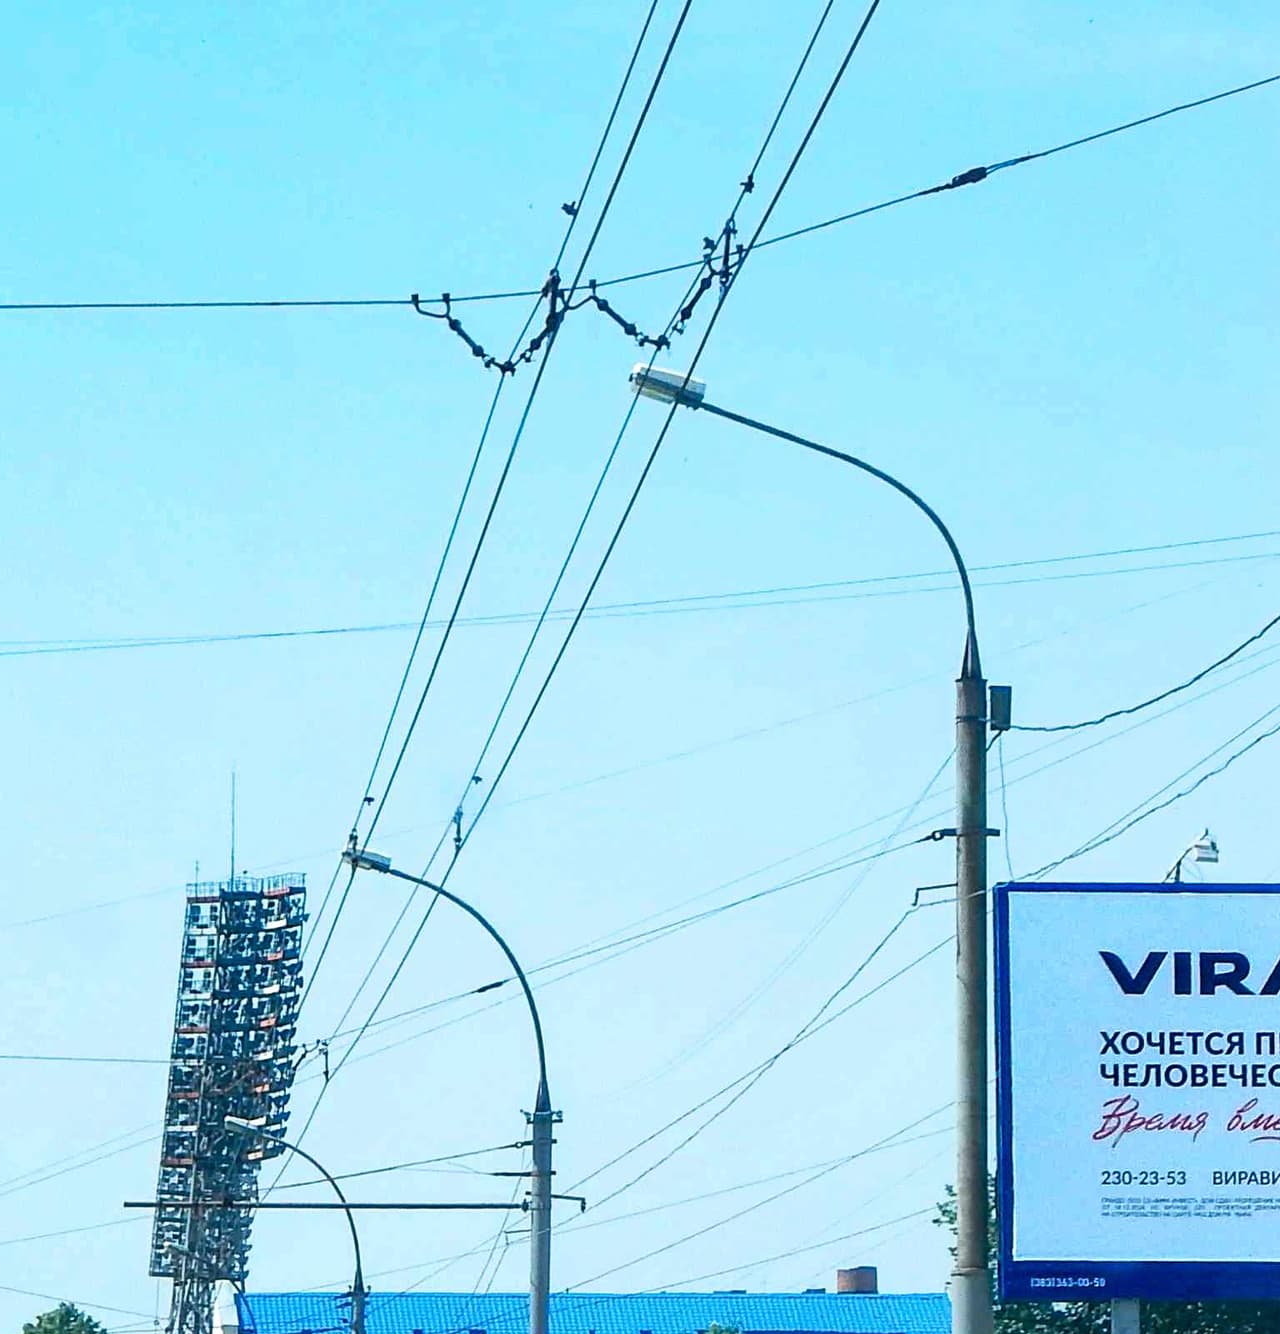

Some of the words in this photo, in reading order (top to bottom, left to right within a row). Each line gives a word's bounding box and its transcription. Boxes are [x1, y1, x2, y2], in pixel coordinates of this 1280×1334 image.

[1100, 1031, 1245, 1056] ХОЧЕТСЯ
[1093, 1094, 1209, 1149] Время
[1101, 1170, 1187, 1186] 230-23-53
